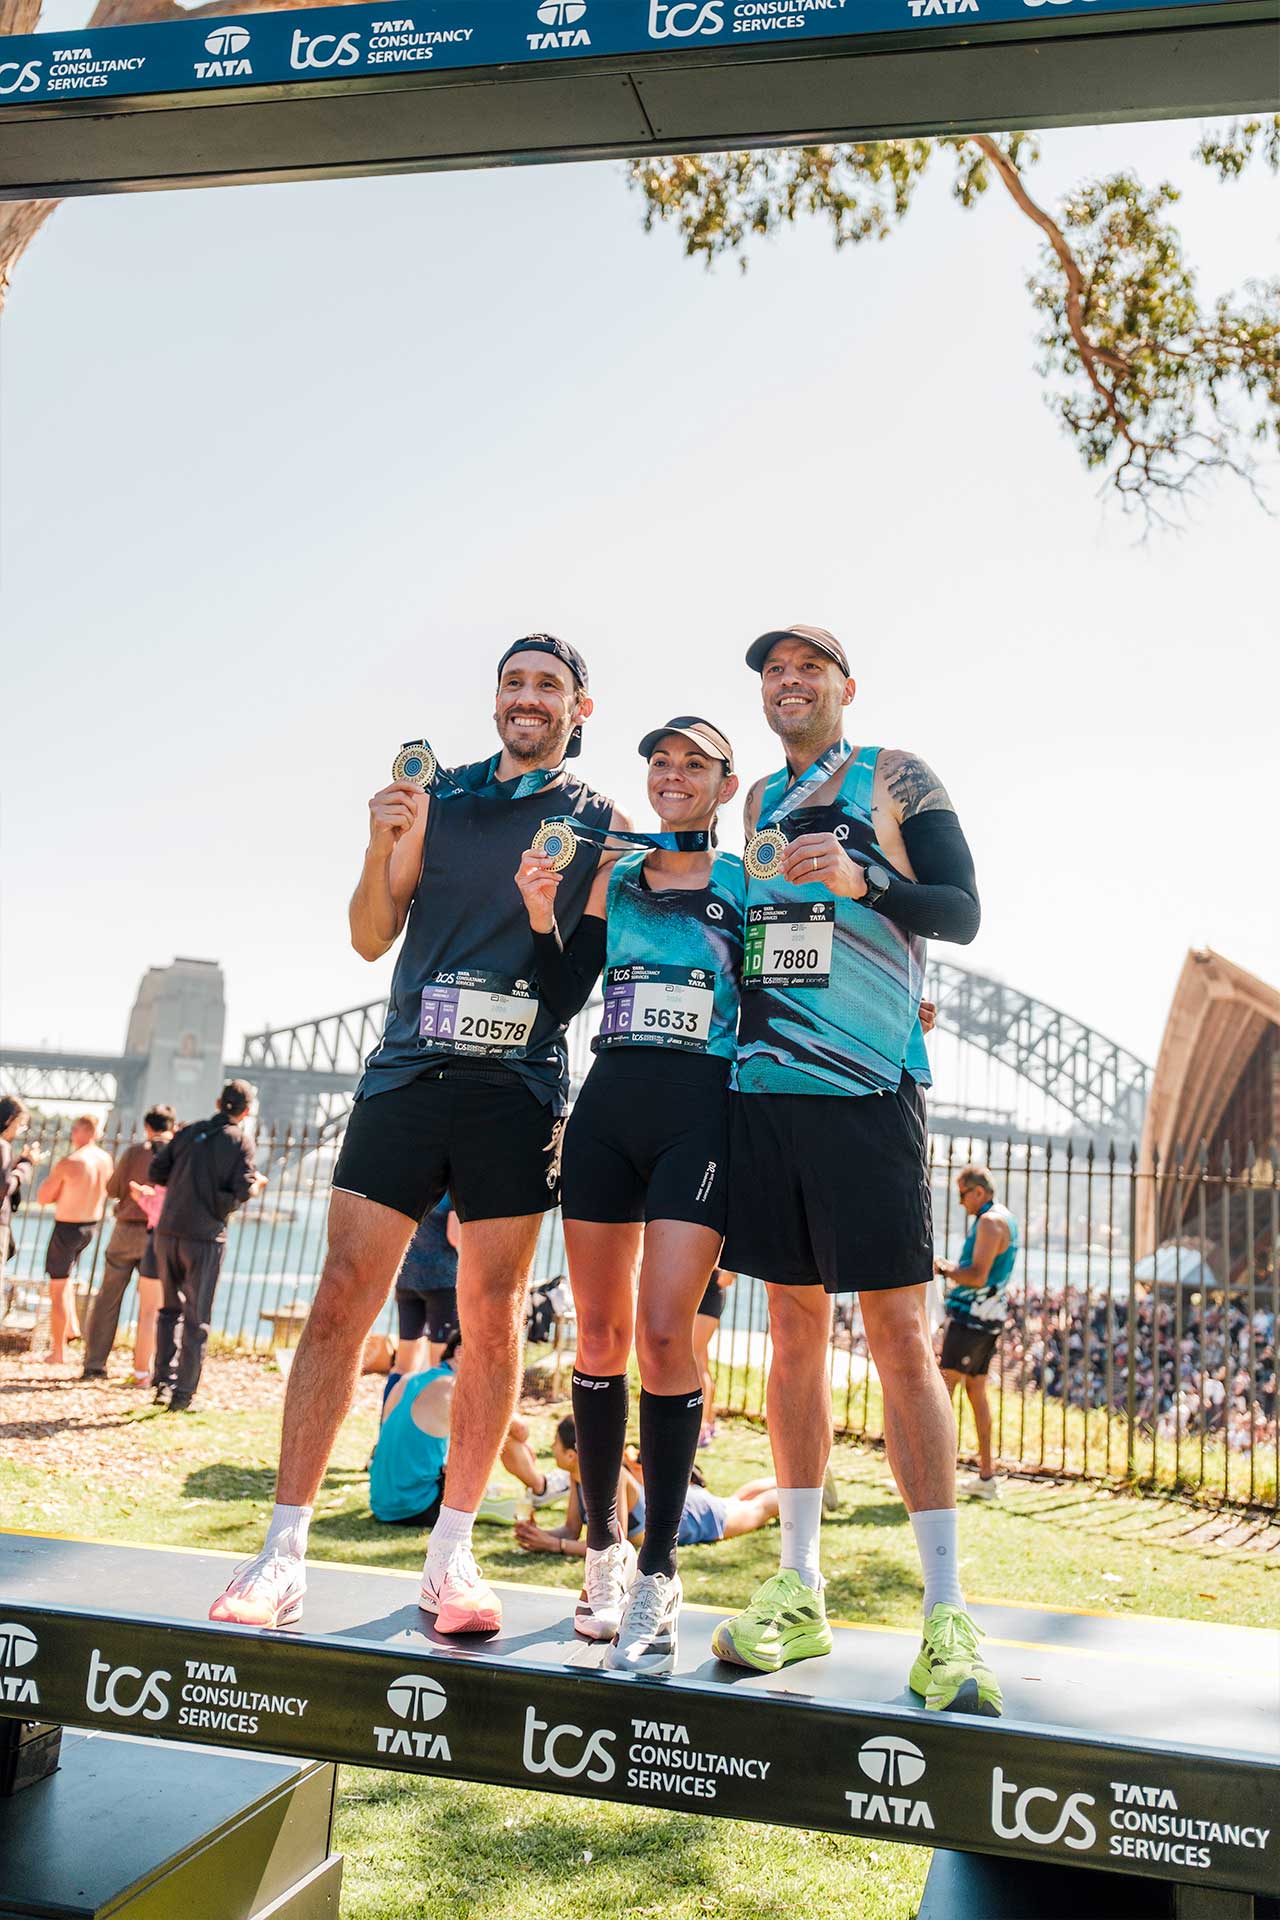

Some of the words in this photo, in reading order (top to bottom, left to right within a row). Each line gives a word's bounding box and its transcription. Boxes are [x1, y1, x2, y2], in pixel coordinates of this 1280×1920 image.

[733, 0, 846, 17] CONSULTANCY
[908, 0, 979, 17] TATA
[371, 20, 415, 33] TATA
[648, 0, 725, 39] tcs
[732, 15, 806, 33] SERVICES
[290, 28, 361, 70] tcs
[369, 29, 474, 49] CONSULTANCY
[527, 29, 592, 50] TATA
[52, 48, 93, 62] TATA
[367, 48, 433, 64] SERVICES
[0, 60, 43, 94] cs
[49, 57, 146, 77] CONSULTANCY
[194, 59, 253, 79] TATA
[46, 74, 108, 91] SERVICES
[750, 909, 762, 922] tcs
[752, 954, 761, 970] D
[773, 949, 818, 969] 7880
[436, 972, 455, 984] tcs
[614, 968, 630, 981] tcs
[688, 979, 706, 988] TATA
[512, 989, 529, 998] TATA
[423, 1015, 434, 1031] 2
[440, 1018, 452, 1034] A
[460, 1016, 528, 1041] 20578
[606, 1013, 612, 1029] 1
[619, 1012, 629, 1027] C
[643, 1008, 699, 1032] 5633
[572, 1375, 610, 1391] cep
[686, 1394, 704, 1409] ce
[185, 1660, 238, 1684] TATA
[0, 1676, 40, 1704] TA
[86, 1648, 172, 1721] tcs
[181, 1684, 309, 1717] CONSULTANCY
[178, 1707, 259, 1735] SERVICES
[631, 1719, 690, 1745] TATA
[373, 1726, 452, 1762] TATA
[522, 1705, 617, 1783] tcs
[629, 1744, 771, 1781] CONSULTANCY
[627, 1768, 717, 1799] SERVICES
[1110, 1782, 1178, 1811] TATA
[845, 1790, 935, 1830] TATA
[991, 1766, 1097, 1850] tcs
[1109, 1809, 1271, 1851] CONSULTANCY
[1109, 1835, 1212, 1869] SERVICES
